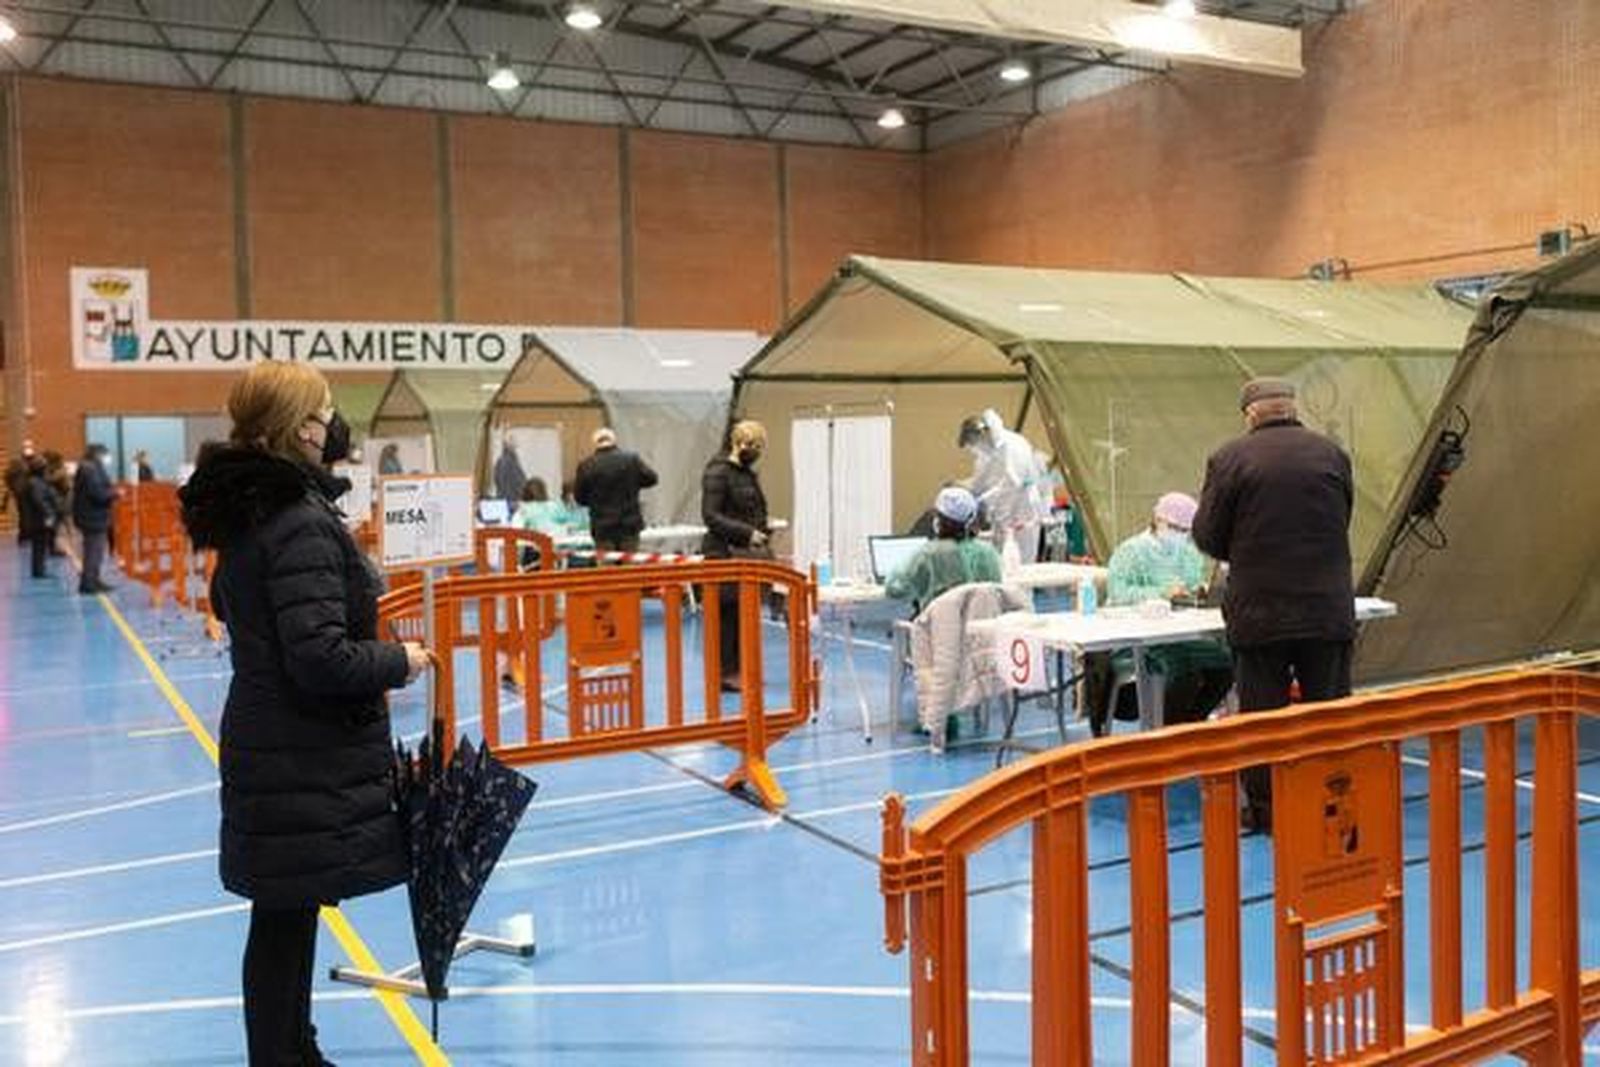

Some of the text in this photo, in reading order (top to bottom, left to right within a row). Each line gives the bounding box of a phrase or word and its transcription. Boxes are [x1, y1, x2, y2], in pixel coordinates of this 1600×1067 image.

[146, 328, 506, 362] AYUNTAMIENTO
[386, 508, 427, 524] MESA
[1010, 639, 1030, 684] 9
